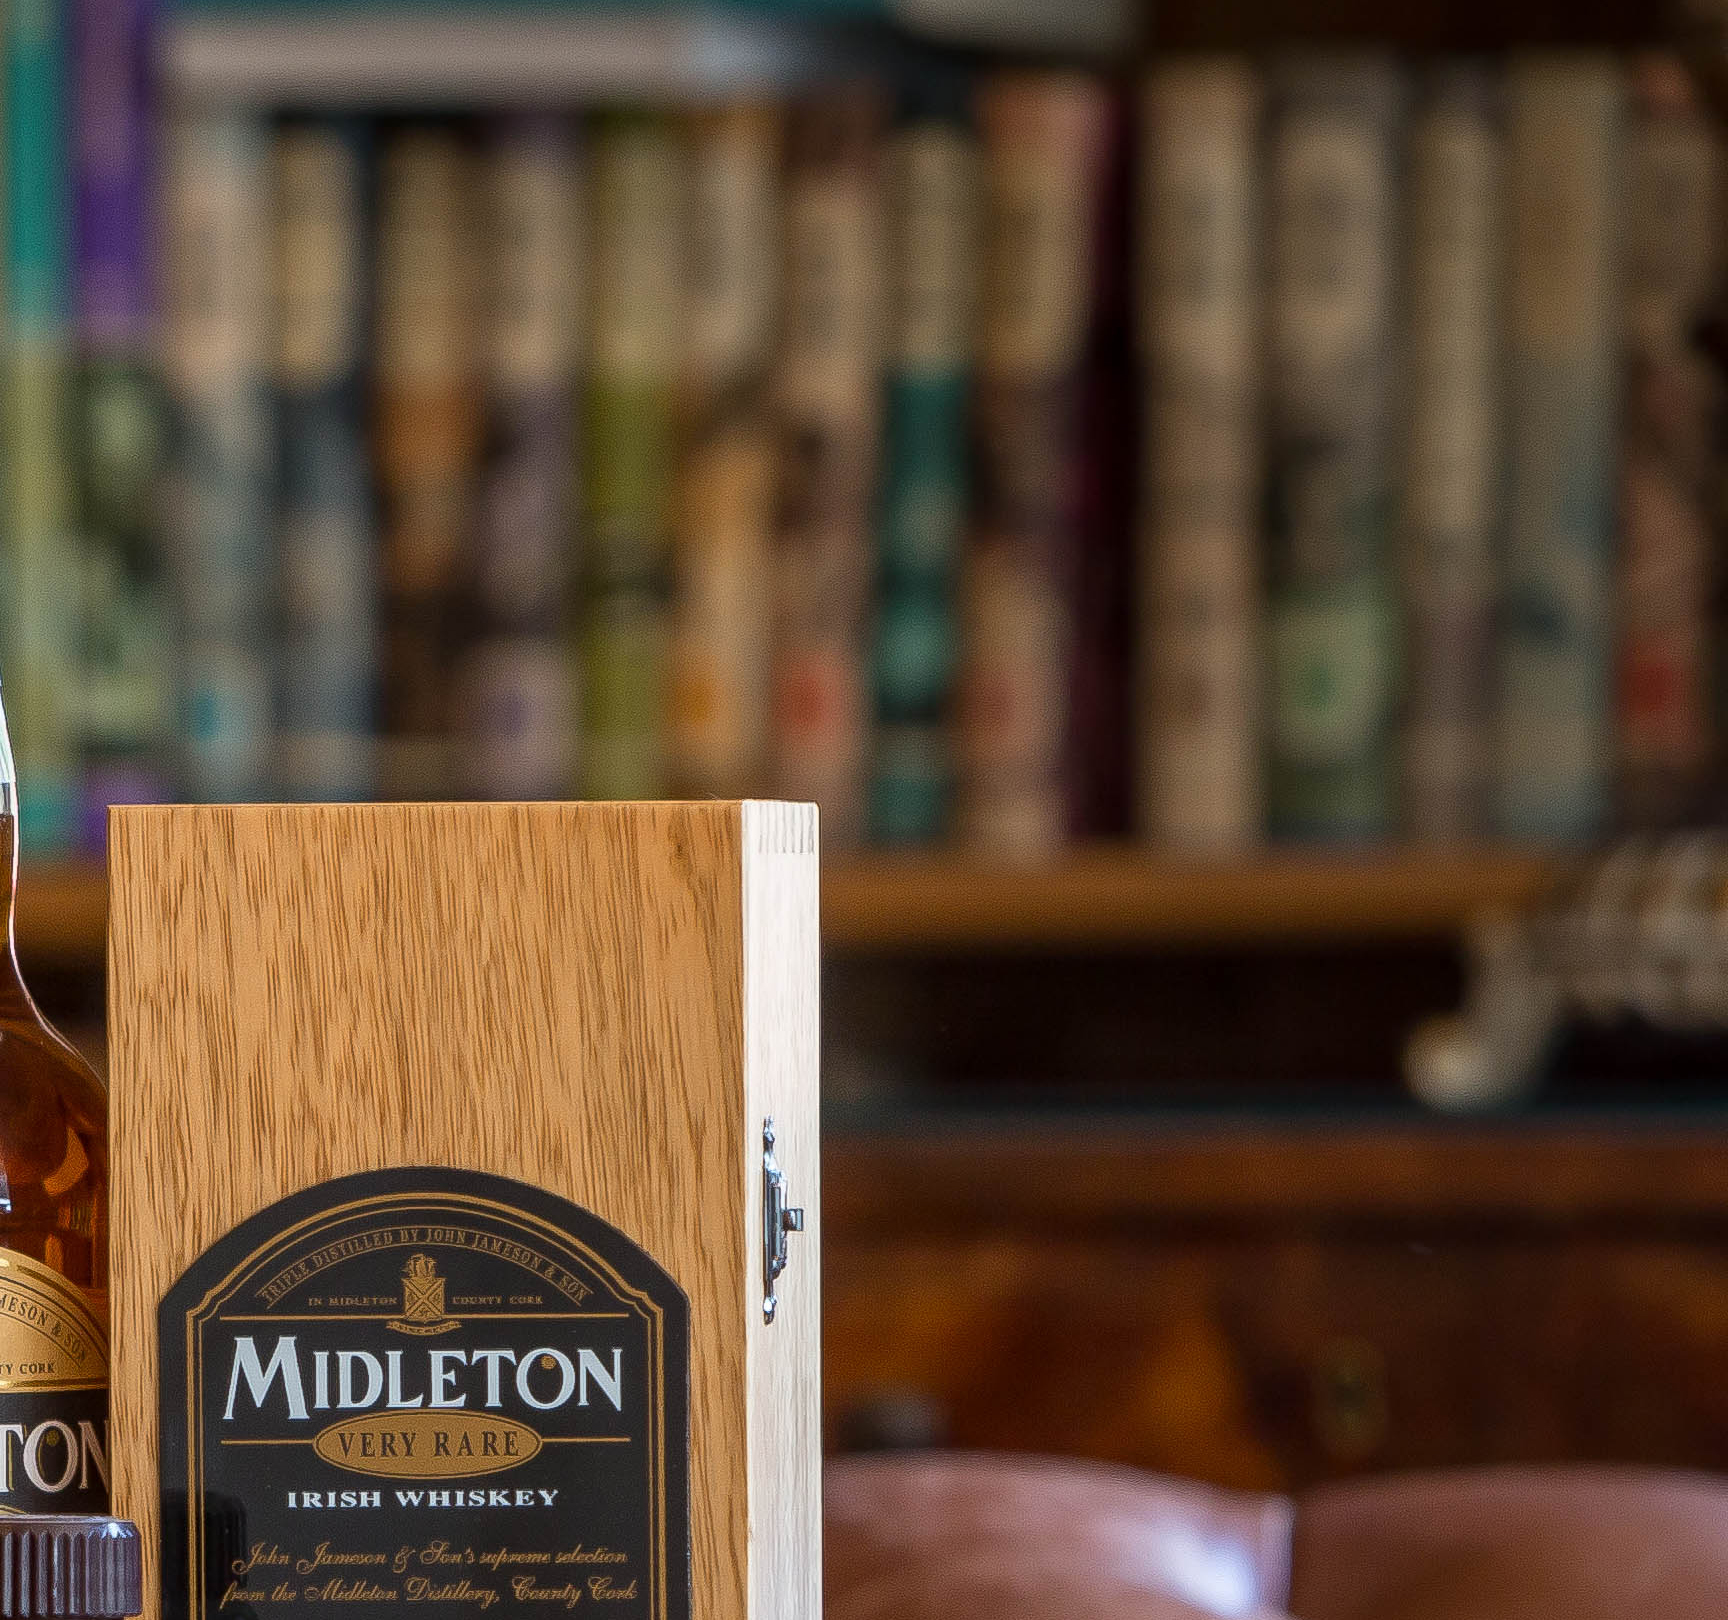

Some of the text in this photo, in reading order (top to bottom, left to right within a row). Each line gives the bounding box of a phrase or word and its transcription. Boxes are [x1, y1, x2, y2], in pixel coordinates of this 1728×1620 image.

[223, 1336, 622, 1420] MIDLETON
[336, 1432, 521, 1458] VERY RARE
[287, 1489, 559, 1508] IRISH WHISKEY
